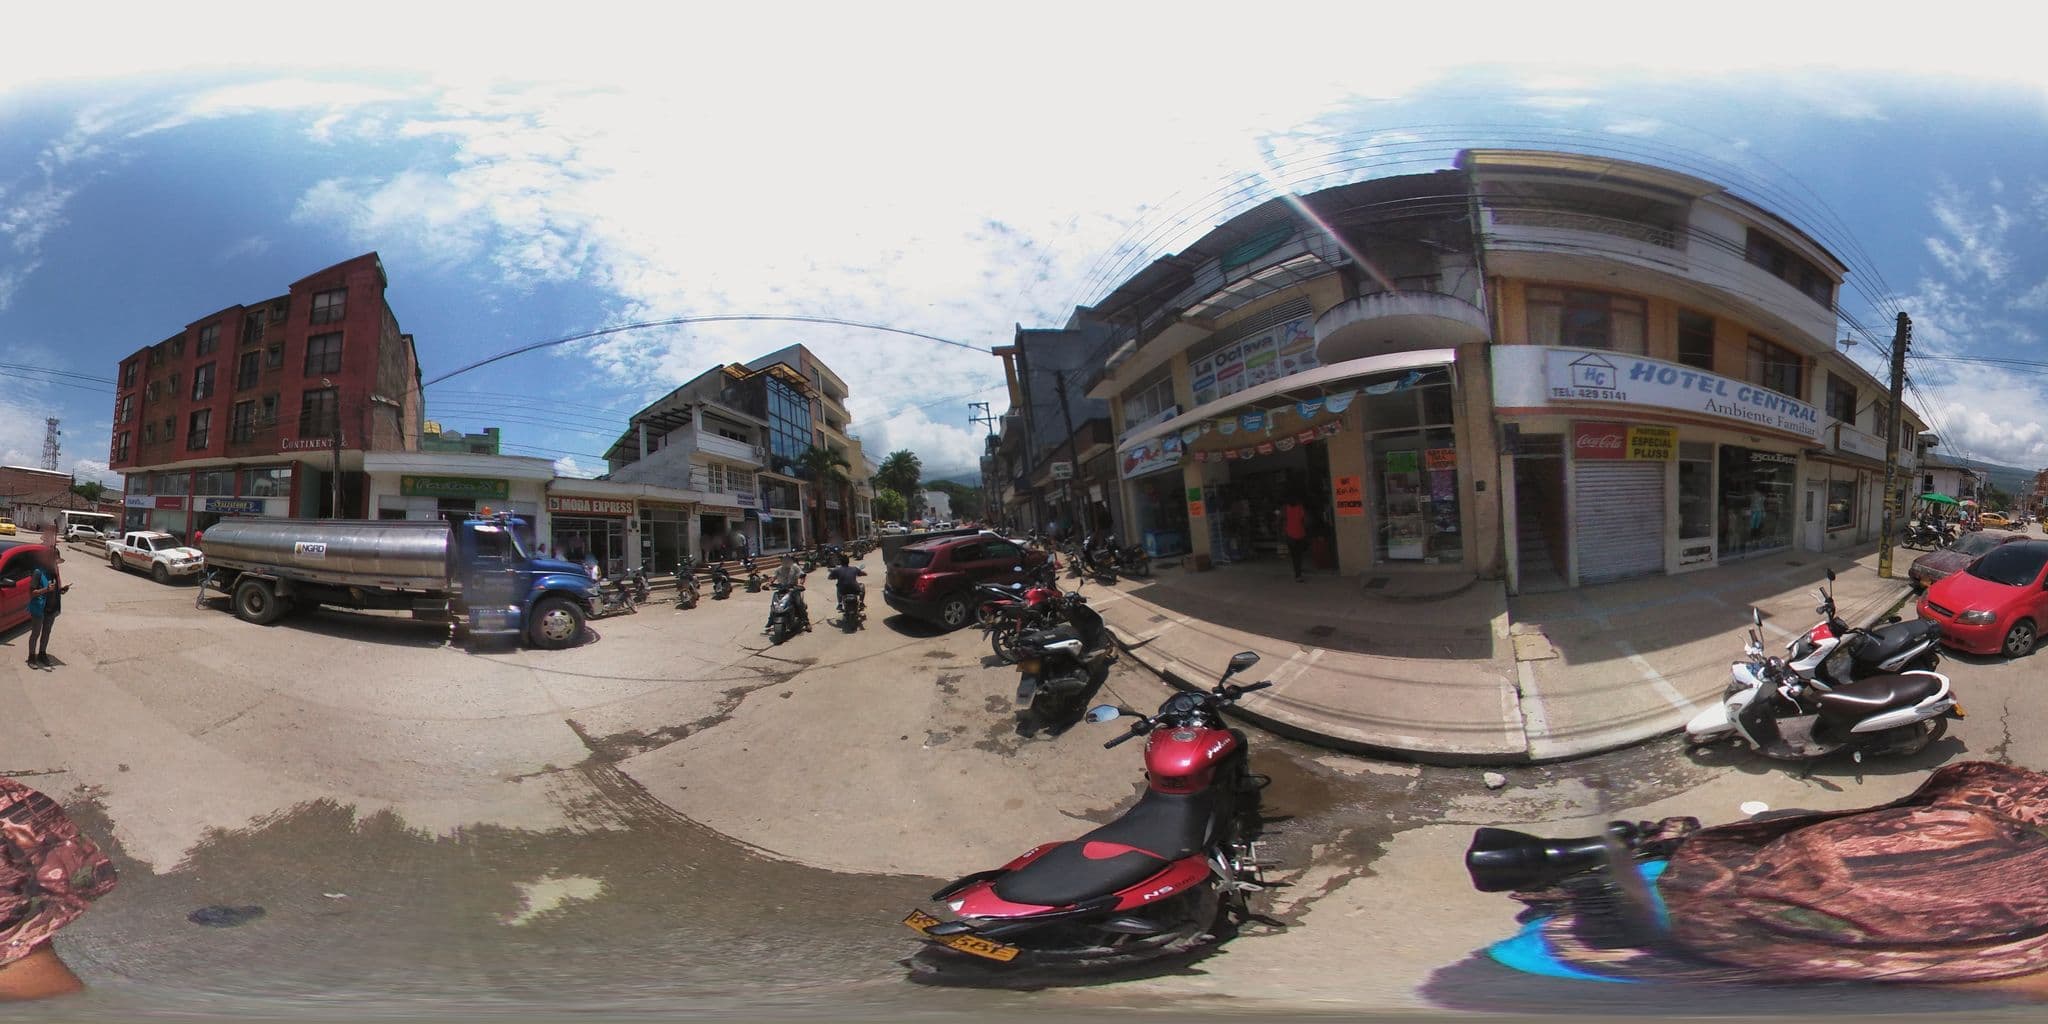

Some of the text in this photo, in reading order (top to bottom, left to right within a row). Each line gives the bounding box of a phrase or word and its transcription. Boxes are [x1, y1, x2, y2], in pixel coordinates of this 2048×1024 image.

[1195, 360, 1212, 377] La
[1215, 336, 1273, 367] Octava
[1578, 389, 1599, 399] 429
[1602, 391, 1627, 401] 5141
[1630, 362, 1817, 423] HOTEL CENTRAL
[1704, 398, 1816, 436] Ambiente Familiar
[1631, 436, 1672, 448] ESPECIAL
[561, 498, 591, 512] MODA
[592, 500, 633, 513] EXPRESS
[1143, 885, 1174, 900] NS
